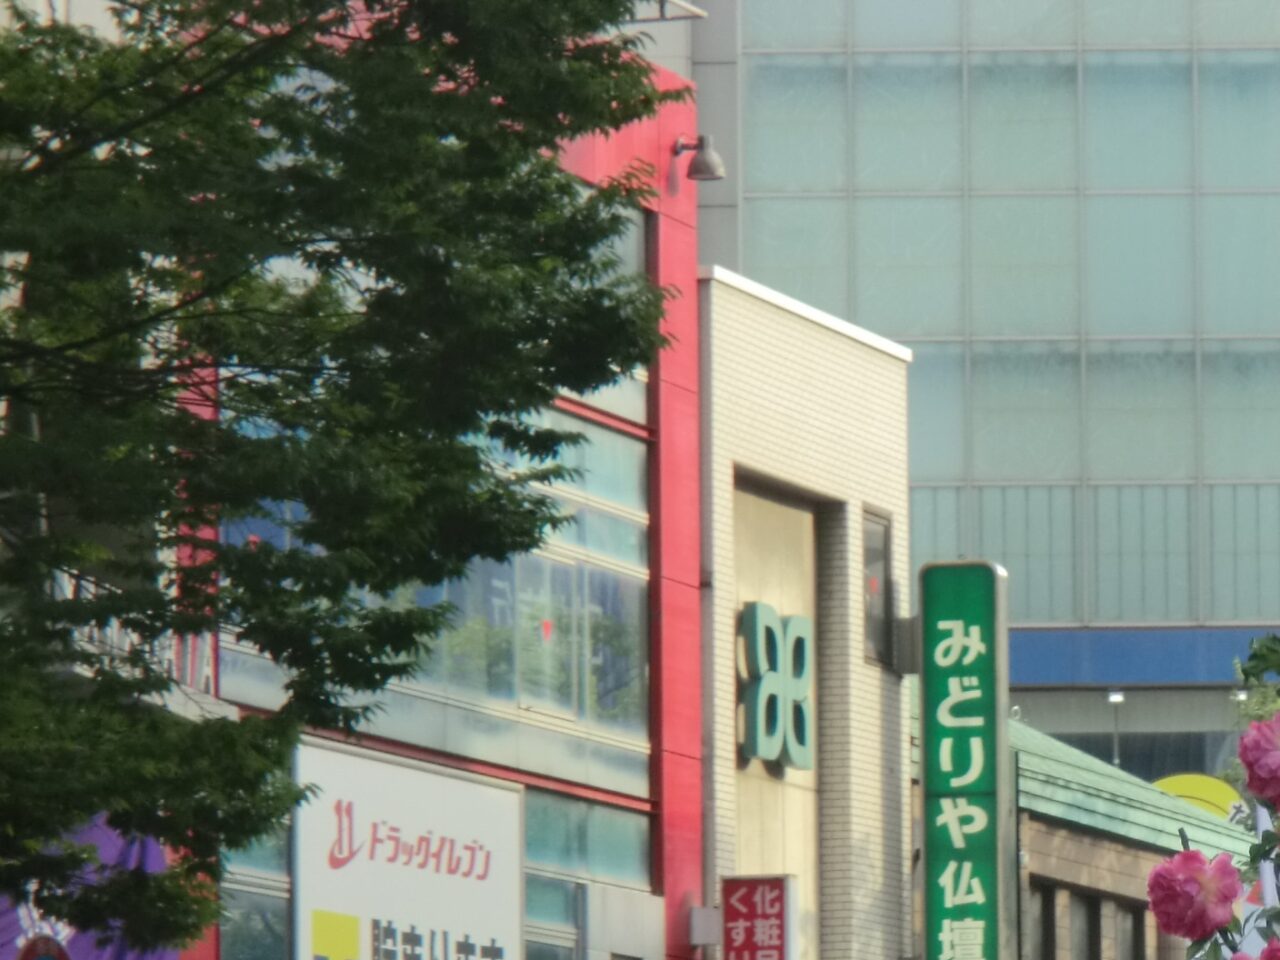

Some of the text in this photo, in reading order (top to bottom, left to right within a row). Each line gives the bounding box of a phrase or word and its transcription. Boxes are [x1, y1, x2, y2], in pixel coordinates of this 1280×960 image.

[368, 820, 491, 881] ドラッグイレブン
